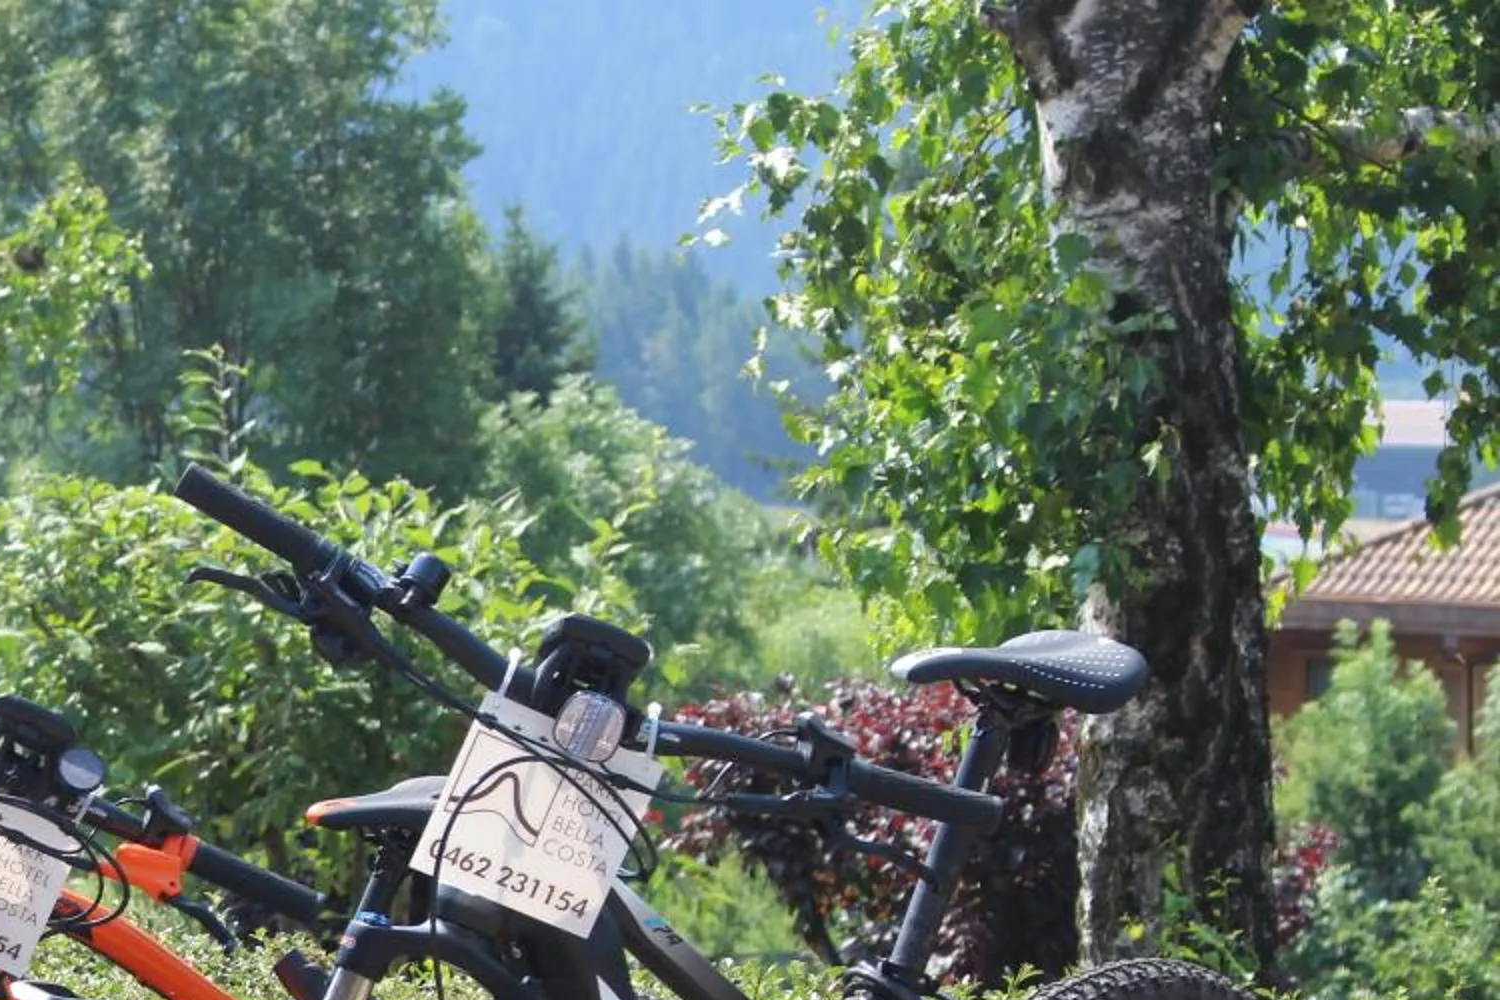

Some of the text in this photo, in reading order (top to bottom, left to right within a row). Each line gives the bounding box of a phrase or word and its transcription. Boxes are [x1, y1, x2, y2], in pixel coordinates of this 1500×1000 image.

[552, 814, 604, 849] BELLA
[542, 837, 608, 877] COSTA
[429, 839, 589, 919] 0462 231154
